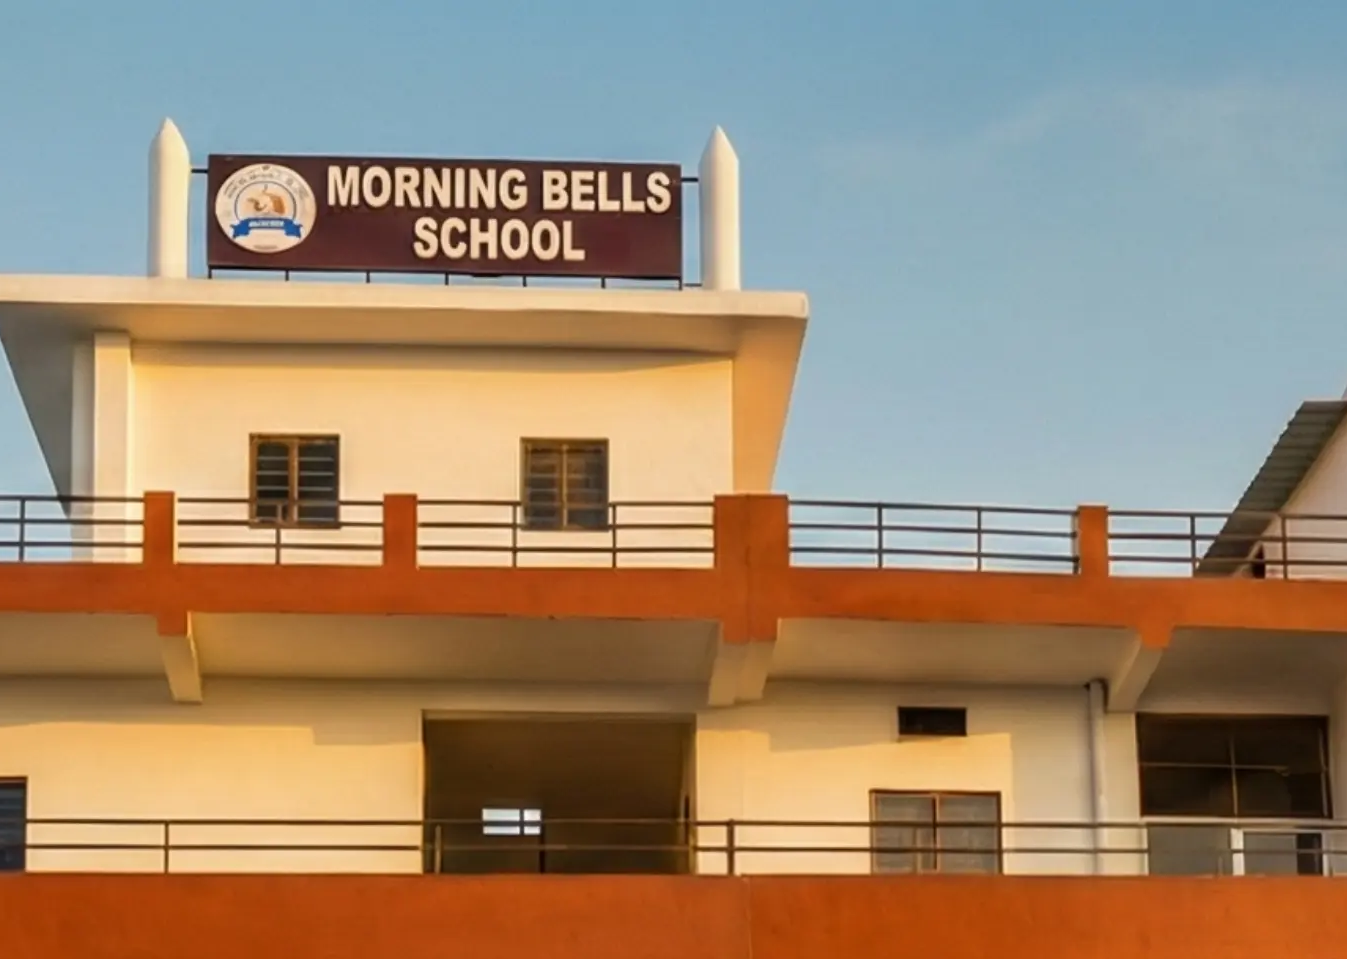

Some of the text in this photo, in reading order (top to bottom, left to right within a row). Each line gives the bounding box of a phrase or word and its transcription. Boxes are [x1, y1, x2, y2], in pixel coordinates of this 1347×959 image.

[327, 165, 528, 210] MORNING
[541, 169, 671, 213] BELLS
[413, 216, 586, 261] SCHOOL
